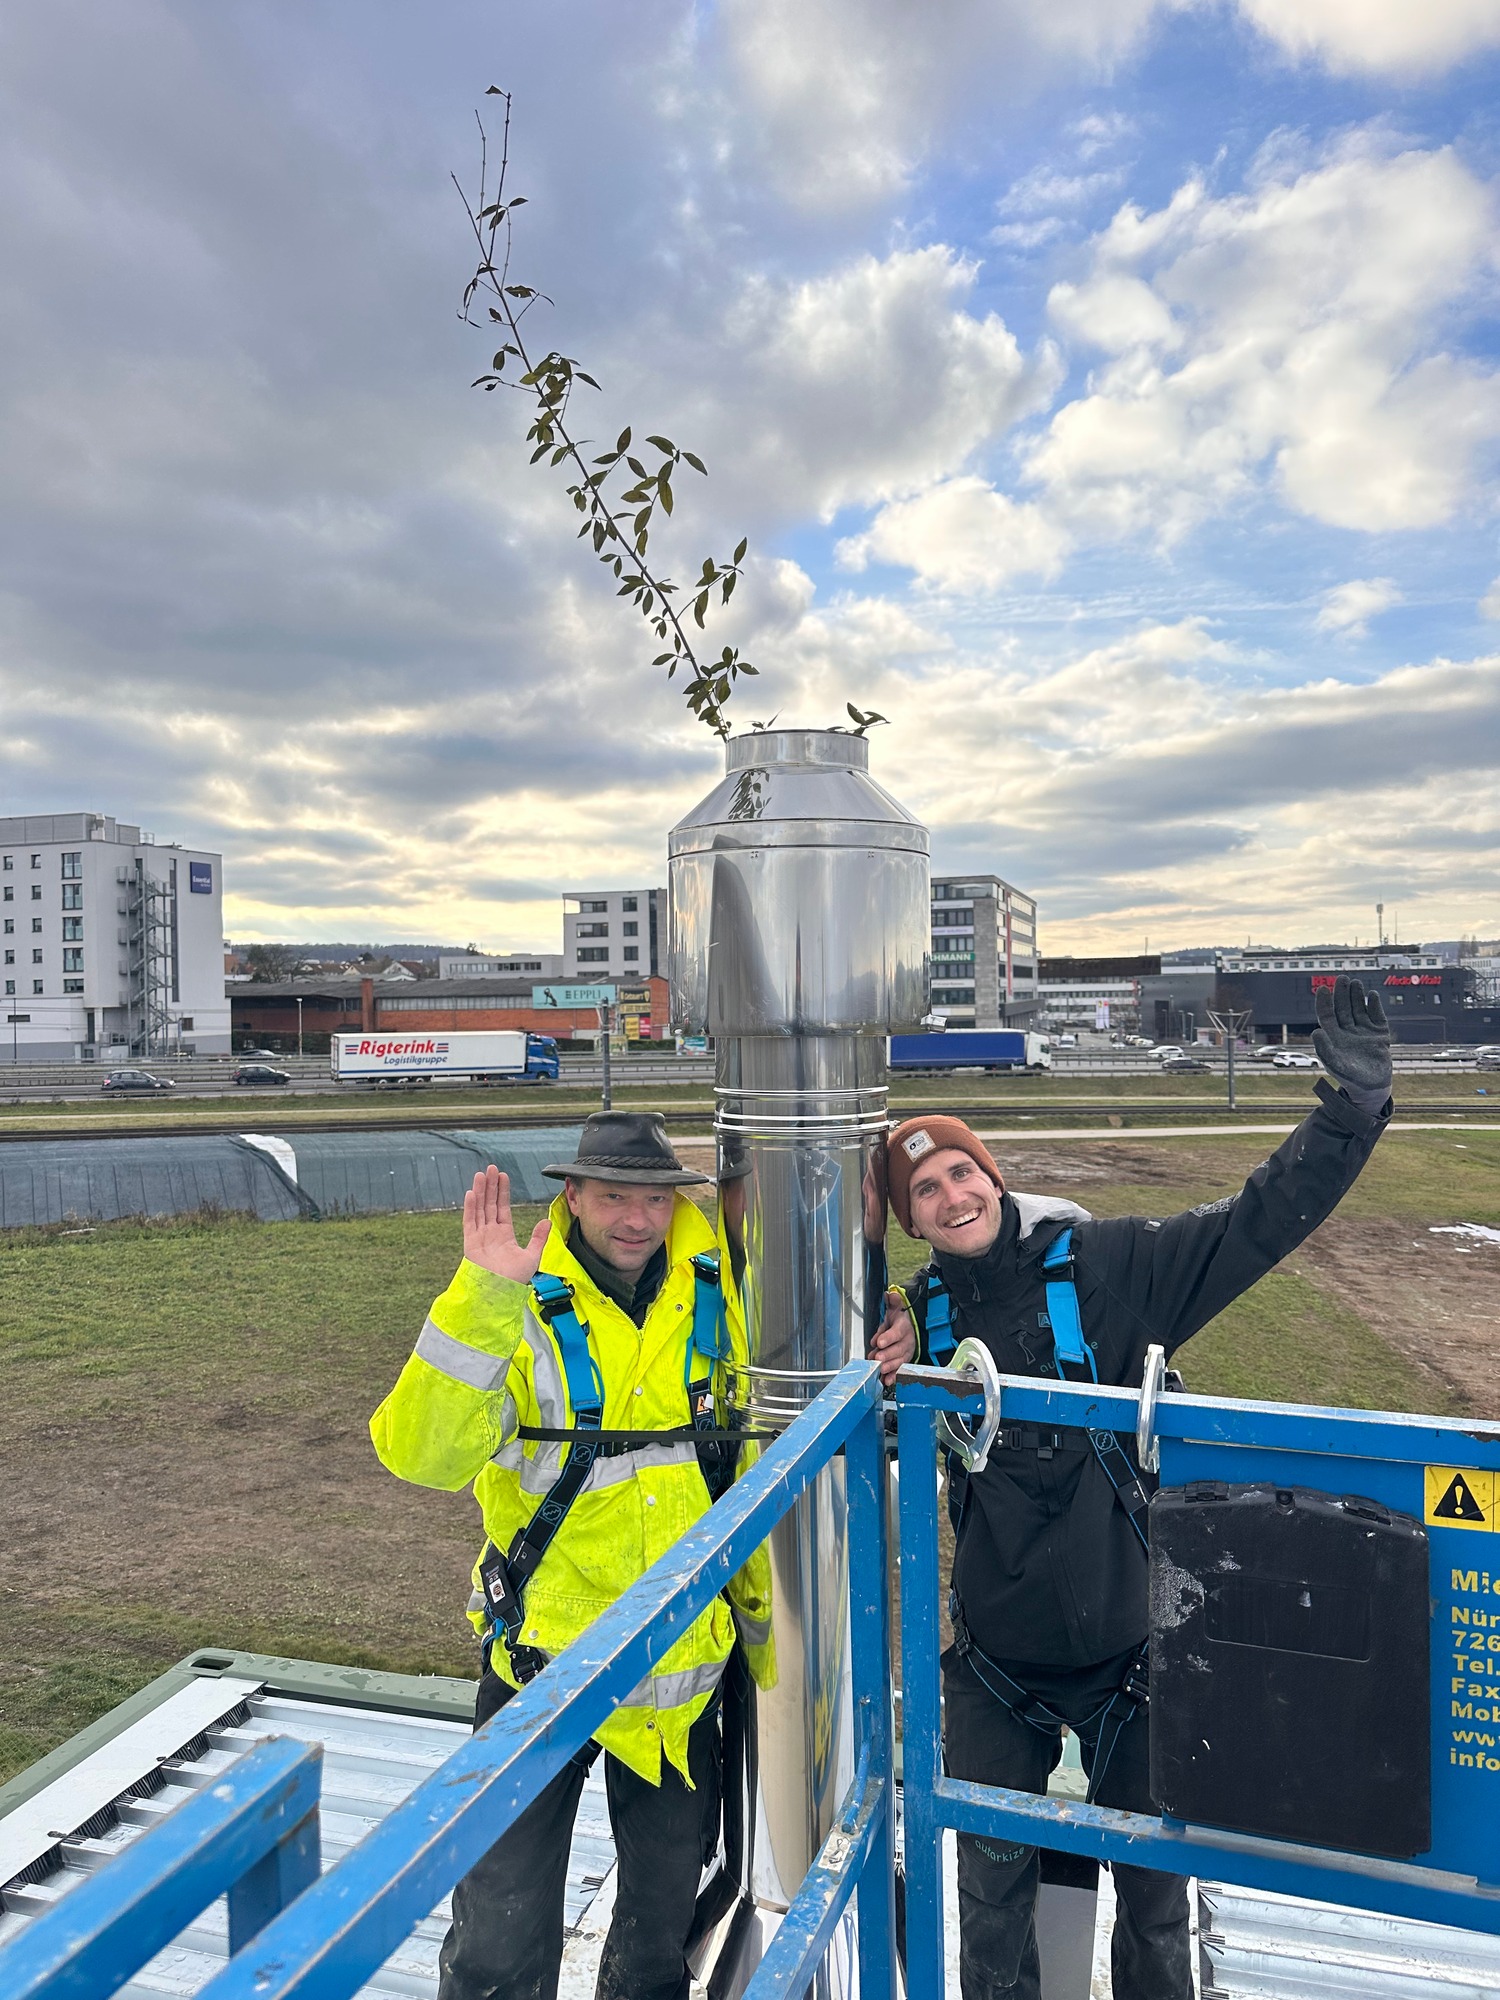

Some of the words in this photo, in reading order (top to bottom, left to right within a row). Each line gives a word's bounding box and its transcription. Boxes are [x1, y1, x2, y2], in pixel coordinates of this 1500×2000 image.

[1311, 975, 1337, 986] REW
[573, 989, 601, 999] EPPLI
[359, 1039, 436, 1058] Rigterink
[384, 1055, 448, 1066] Logistikgruppe
[1451, 1606, 1500, 1628] Nür
[1452, 1630, 1500, 1652] 726
[1451, 1677, 1500, 1699] Fax
[1452, 1730, 1500, 1747] ww
[1450, 1747, 1500, 1771] info
[974, 1839, 1025, 1862] autarkize
